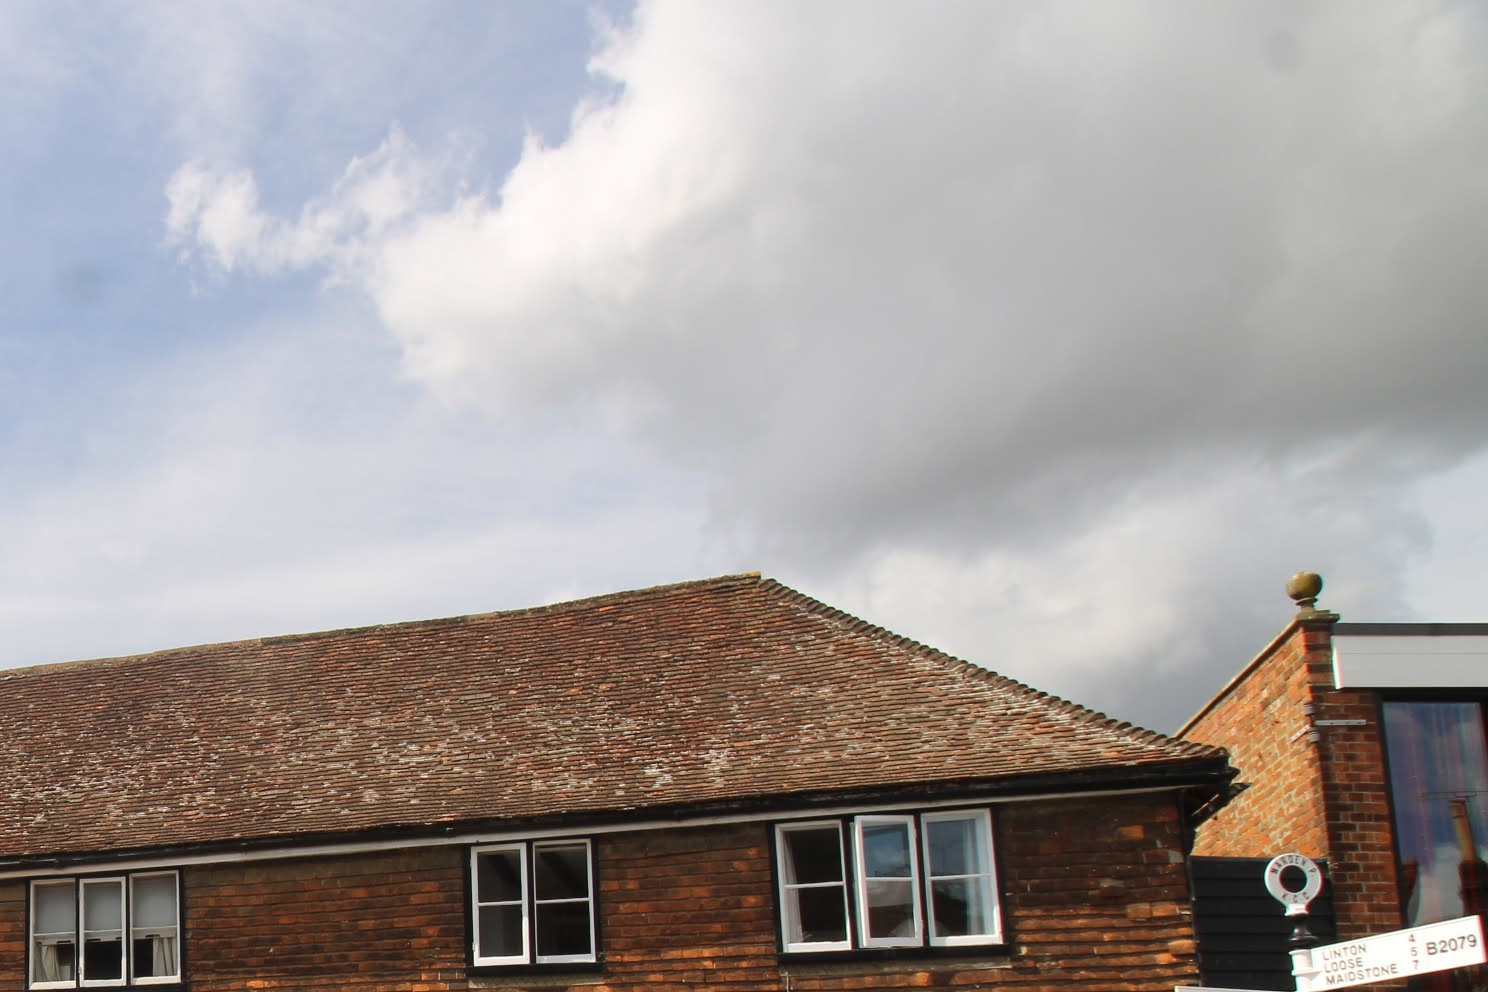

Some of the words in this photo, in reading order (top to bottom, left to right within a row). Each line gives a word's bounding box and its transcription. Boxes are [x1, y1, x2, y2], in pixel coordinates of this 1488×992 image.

[1322, 943, 1367, 961] LINTON
[1408, 933, 1415, 943] 4
[1426, 933, 1477, 956] B2079
[1324, 957, 1364, 973] LOOSE
[1410, 946, 1418, 957] 5
[1325, 963, 1399, 985] MAIDSTONE
[1412, 960, 1419, 970] 7
